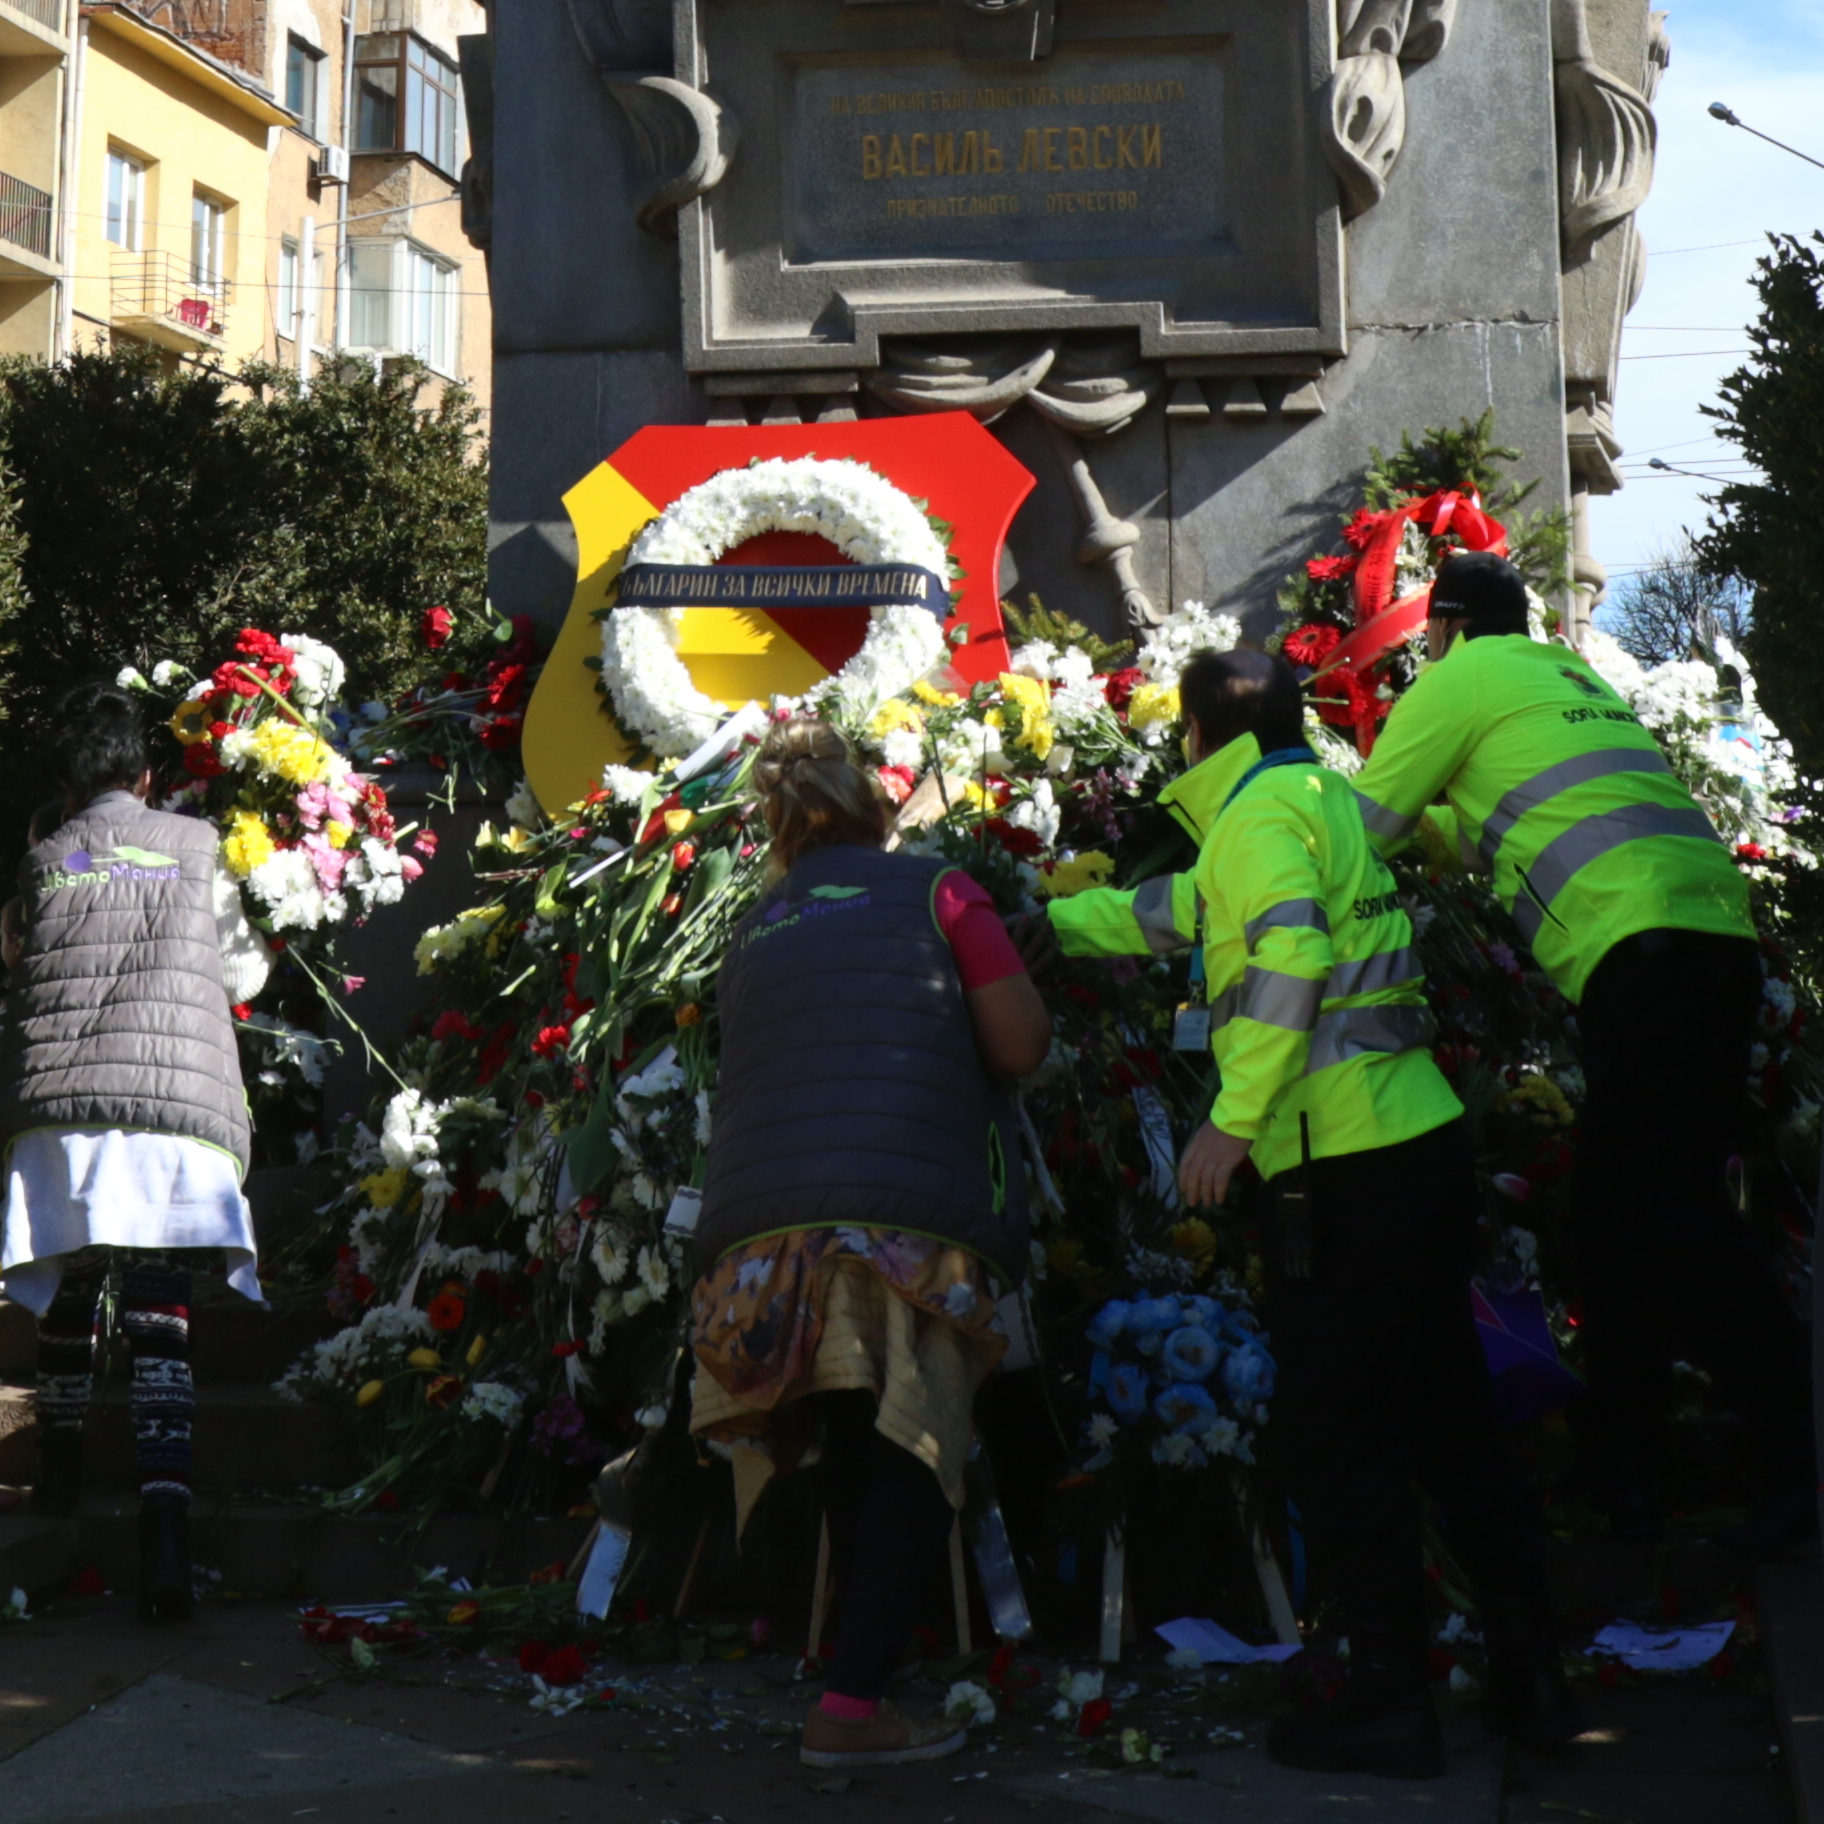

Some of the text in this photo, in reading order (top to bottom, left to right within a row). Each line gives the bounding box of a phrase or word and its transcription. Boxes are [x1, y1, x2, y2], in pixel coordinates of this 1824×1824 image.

[1063, 85, 1085, 105] НА
[861, 124, 1163, 180] ВАСИЛЬ ЛЕВСКИ
[886, 194, 1019, 219] ПРИЗНАТЕЛНОТО
[623, 571, 926, 599] БЪЛГАРИН ЗА ВСИЧКИ ВРЕМЕНА
